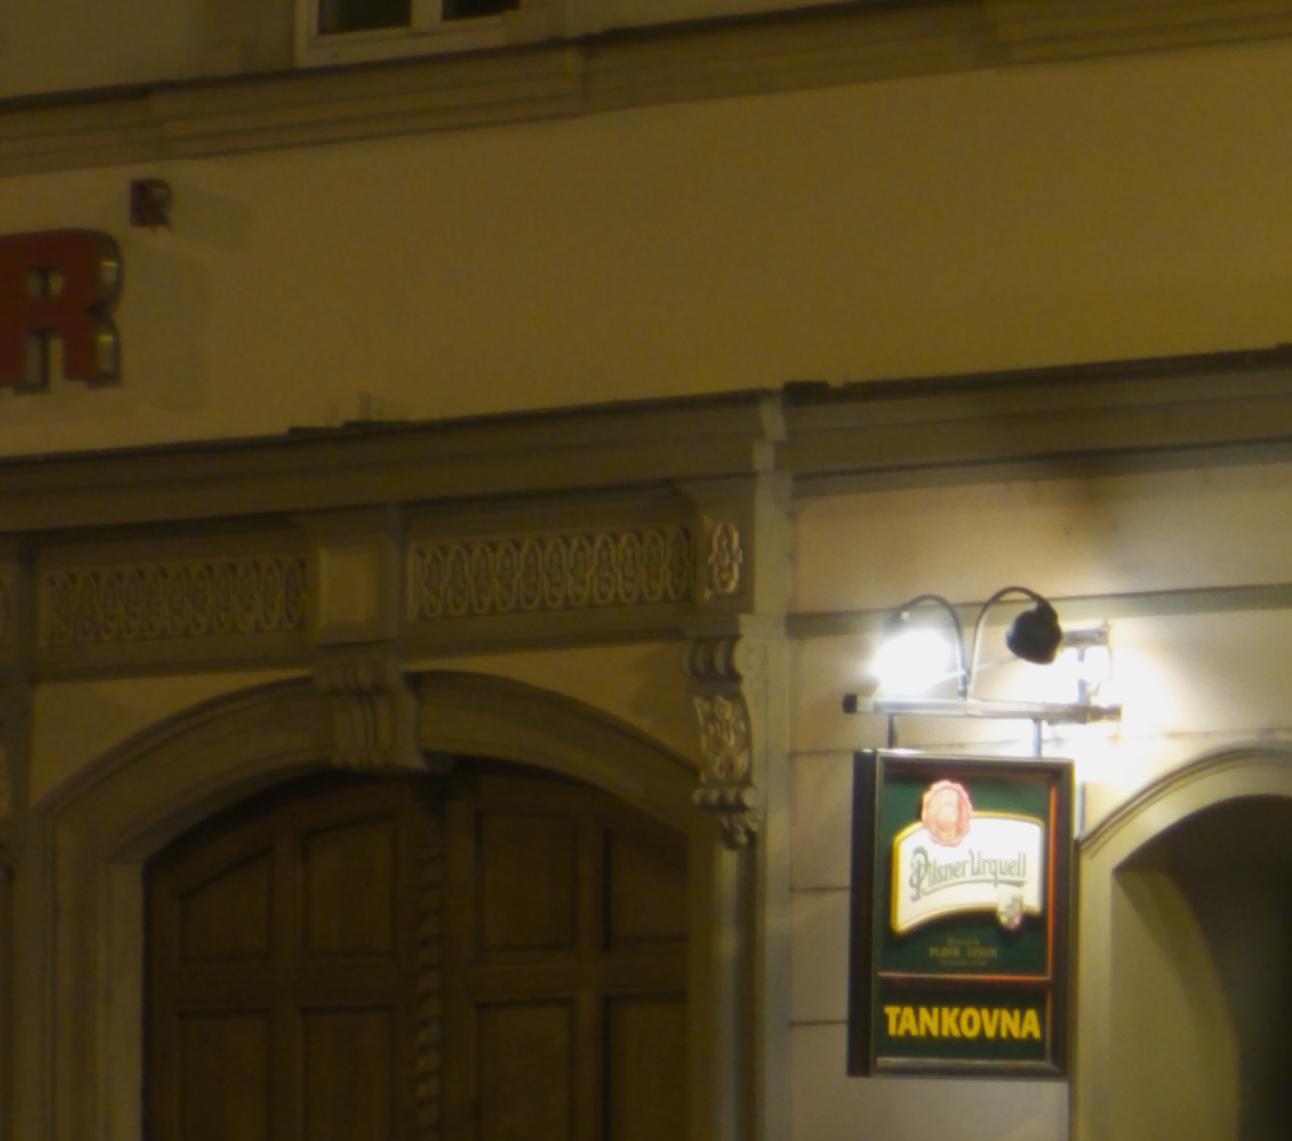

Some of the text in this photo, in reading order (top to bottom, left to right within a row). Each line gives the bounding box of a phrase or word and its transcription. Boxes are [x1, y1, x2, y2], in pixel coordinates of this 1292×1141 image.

[908, 845, 1027, 903] Pilsner Urquell
[884, 1004, 1041, 1040] TANKOVNA
